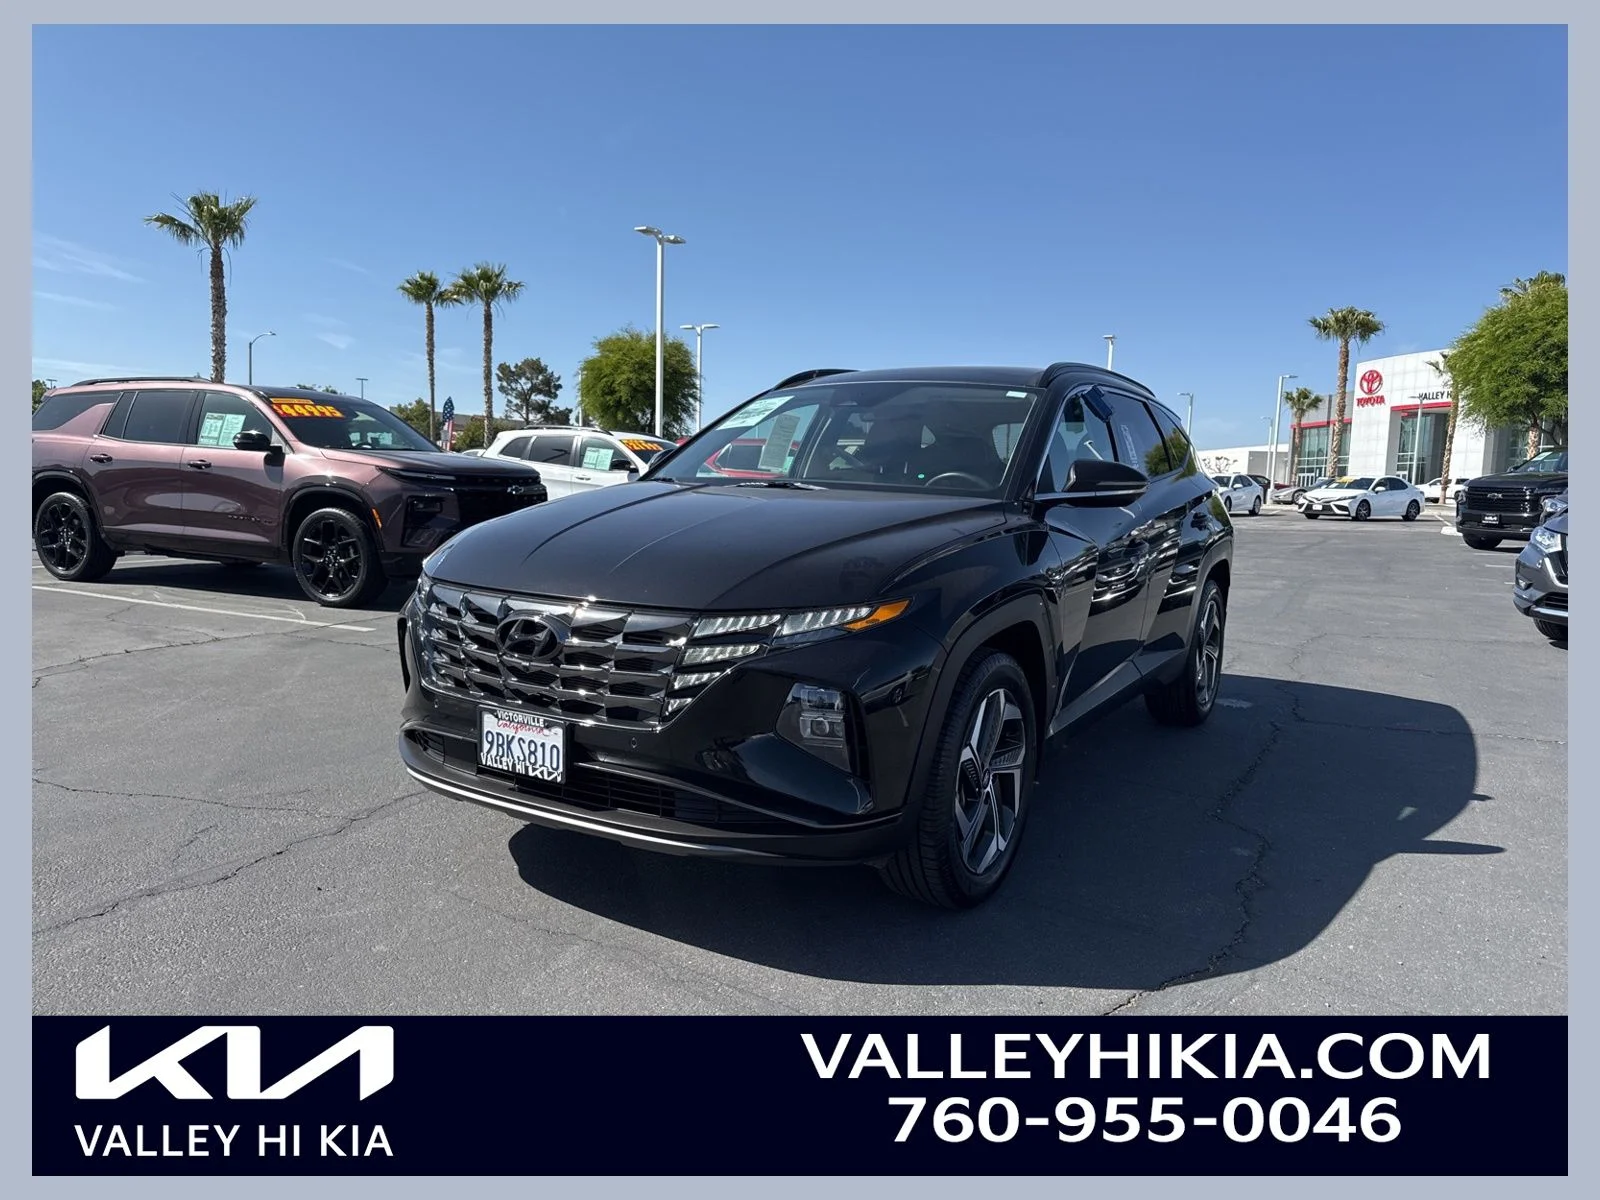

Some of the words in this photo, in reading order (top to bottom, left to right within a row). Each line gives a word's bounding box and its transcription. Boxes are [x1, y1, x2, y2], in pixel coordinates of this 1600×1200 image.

[1356, 395, 1386, 408] TOYOTA
[1418, 391, 1445, 401] VALLEY
[497, 710, 545, 727] VICTORVILLE
[485, 730, 560, 772] 9BKS810
[480, 752, 514, 772] VALLEY
[514, 761, 526, 775] HI
